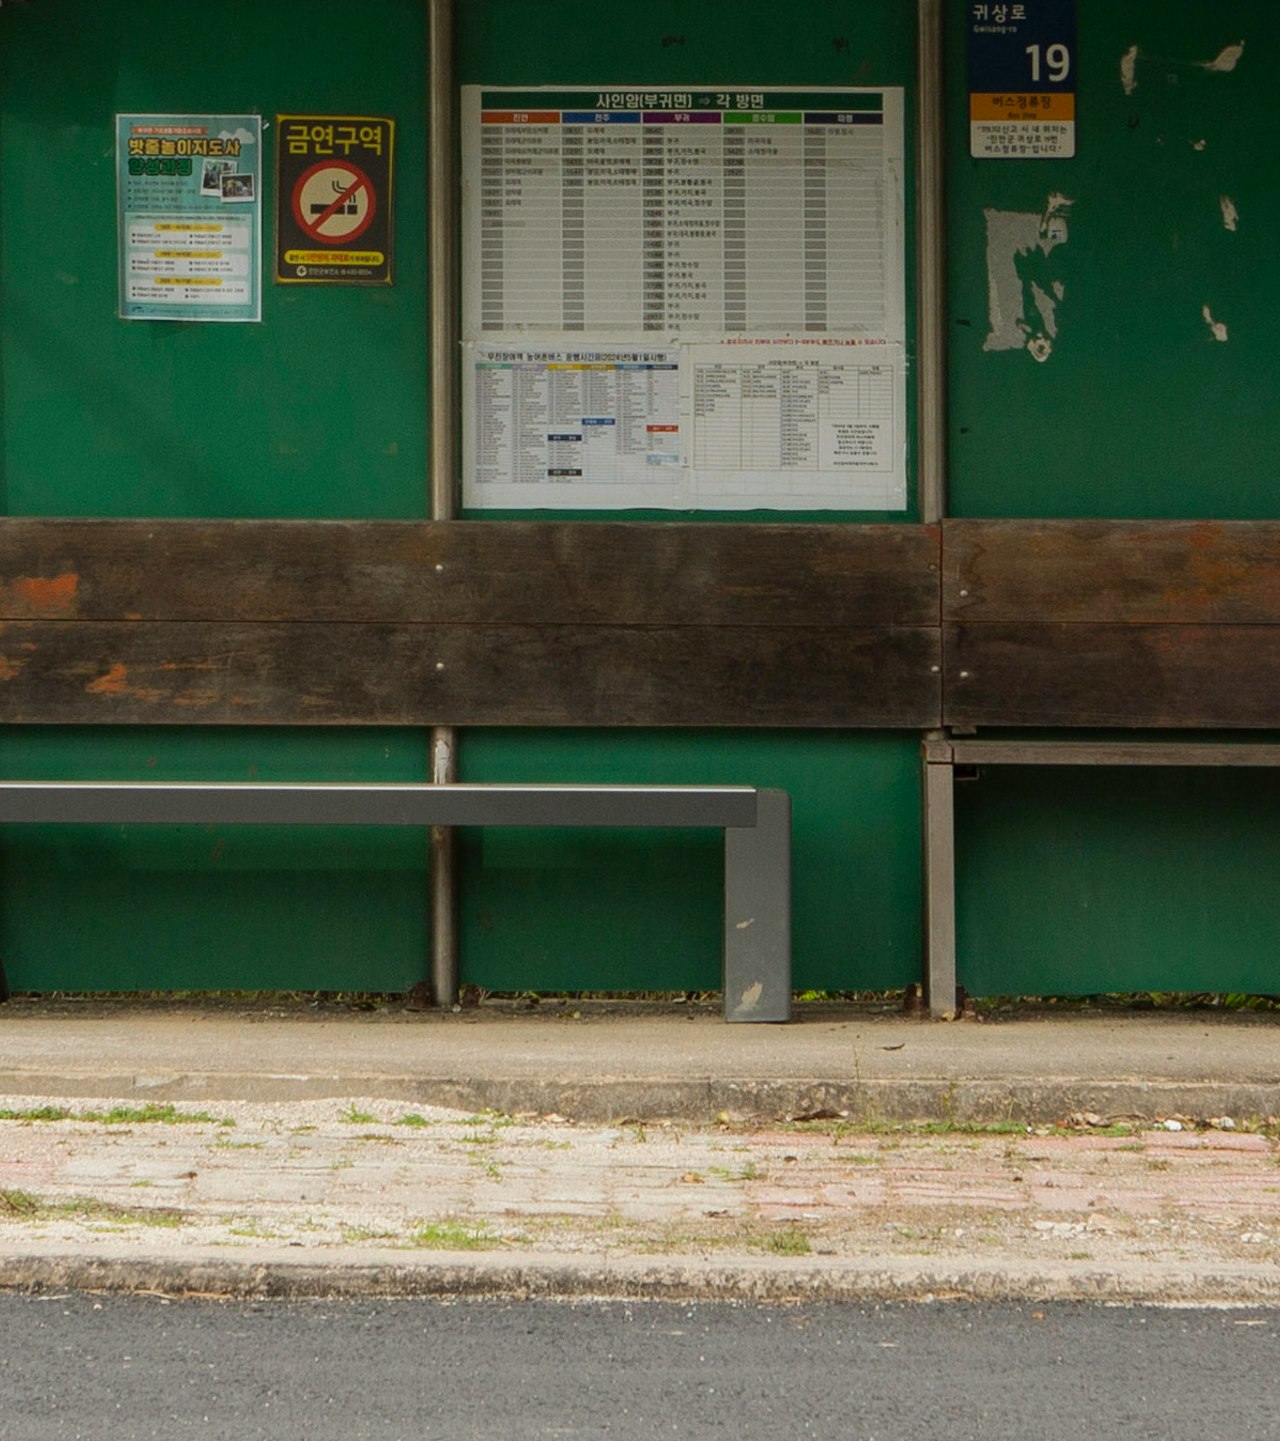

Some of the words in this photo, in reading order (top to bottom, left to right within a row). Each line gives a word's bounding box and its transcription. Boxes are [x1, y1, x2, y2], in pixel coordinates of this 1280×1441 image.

[973, 4, 1027, 22] 귀상로
[973, 24, 1018, 34] Gwisang-ro
[1025, 44, 1070, 82] 19
[596, 92, 693, 110] 사인암(부귀면)
[716, 93, 735, 110] 각
[737, 93, 765, 110] 방면
[992, 96, 1052, 109] 버스정류장
[128, 138, 240, 157] 밧줄놀이지도사
[286, 125, 383, 156] 금연구역
